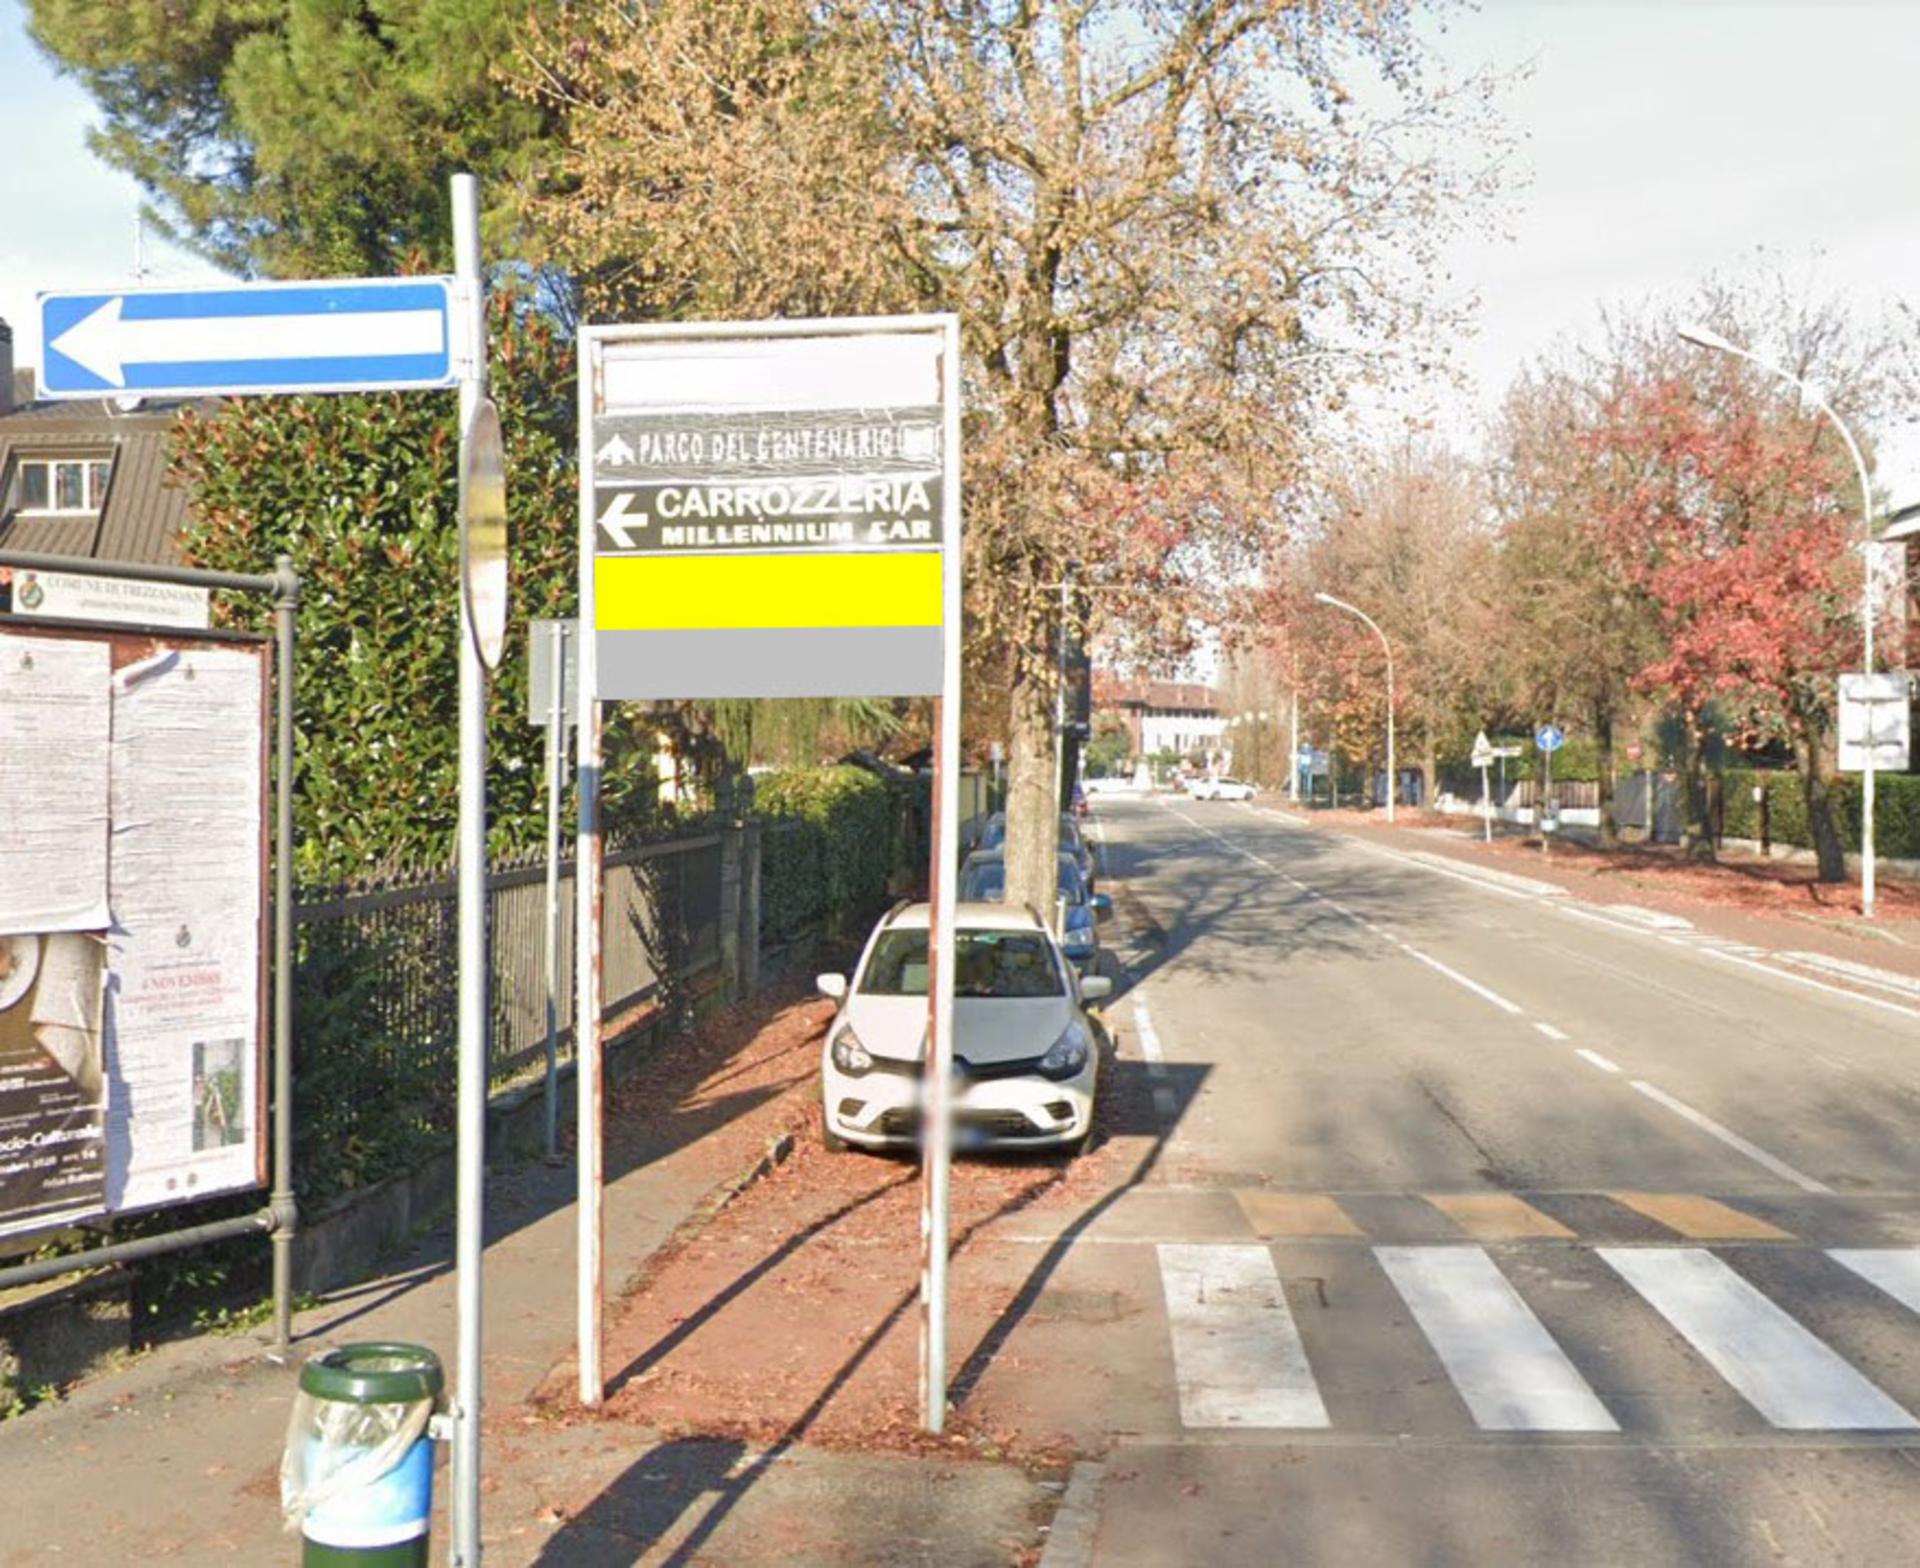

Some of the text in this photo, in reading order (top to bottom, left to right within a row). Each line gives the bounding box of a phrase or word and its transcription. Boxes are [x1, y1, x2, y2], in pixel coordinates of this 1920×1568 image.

[638, 427, 893, 463] PARCO DEL CENTENARIO
[655, 480, 931, 518] CARROZZERIA
[661, 519, 932, 546] MILLENNIUM CAR
